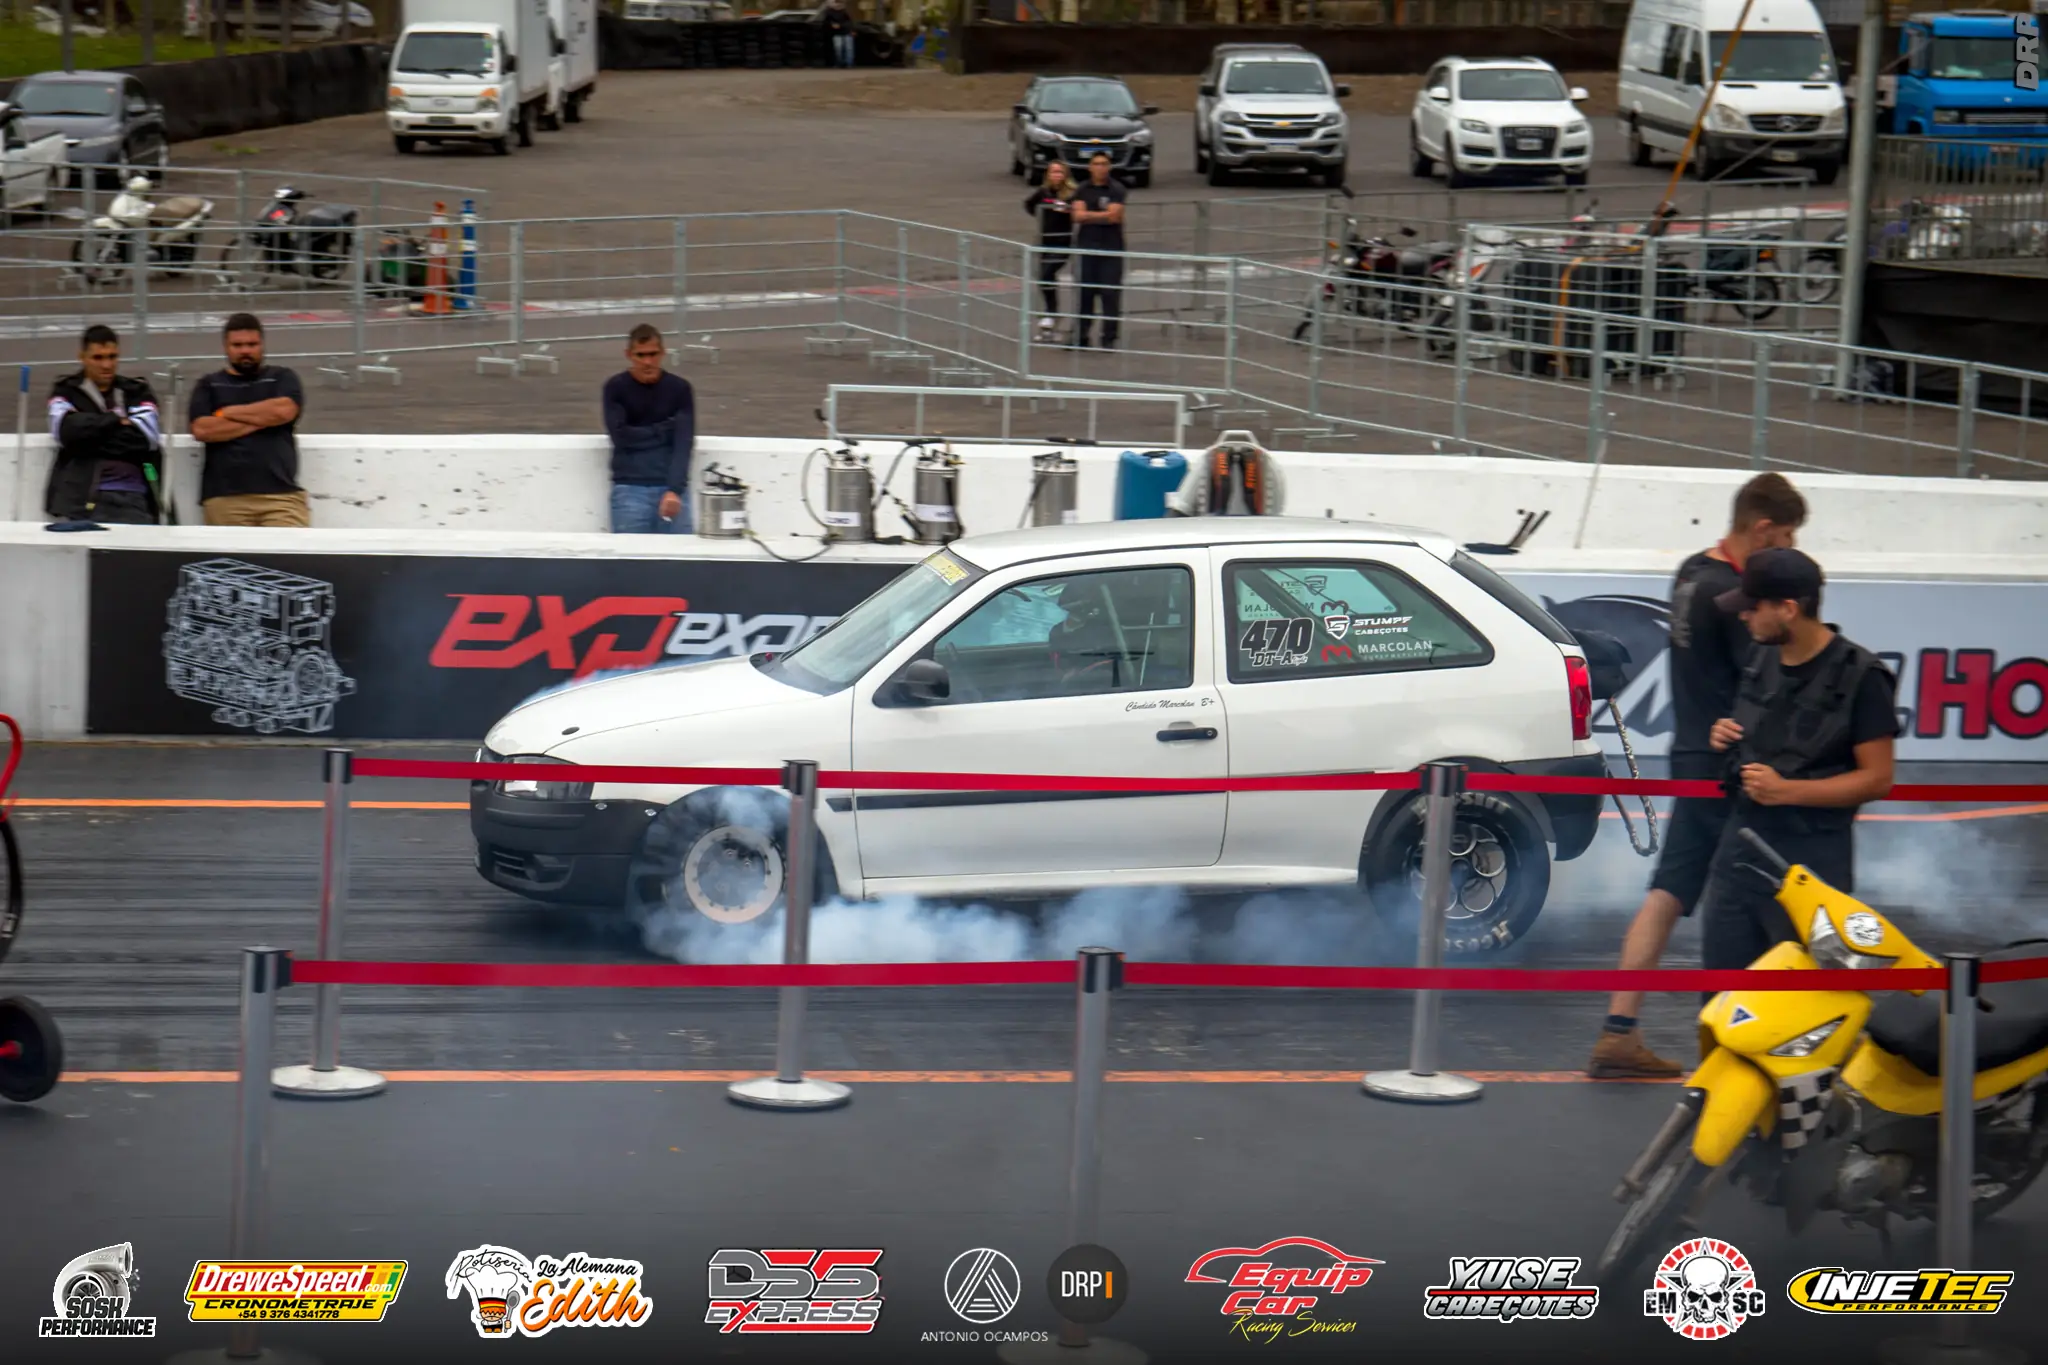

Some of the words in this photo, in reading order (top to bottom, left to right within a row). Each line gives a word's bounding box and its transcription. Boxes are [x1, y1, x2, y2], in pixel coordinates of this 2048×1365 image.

[1352, 615, 1413, 627] STUMPF
[1240, 617, 1315, 659] 470
[1354, 626, 1409, 636] CABEÇOTES
[1358, 639, 1433, 655] MARCOLAN
[1252, 650, 1293, 666] DT-A
[1125, 701, 1157, 712] Cândido
[1158, 699, 1196, 709] Marcolan
